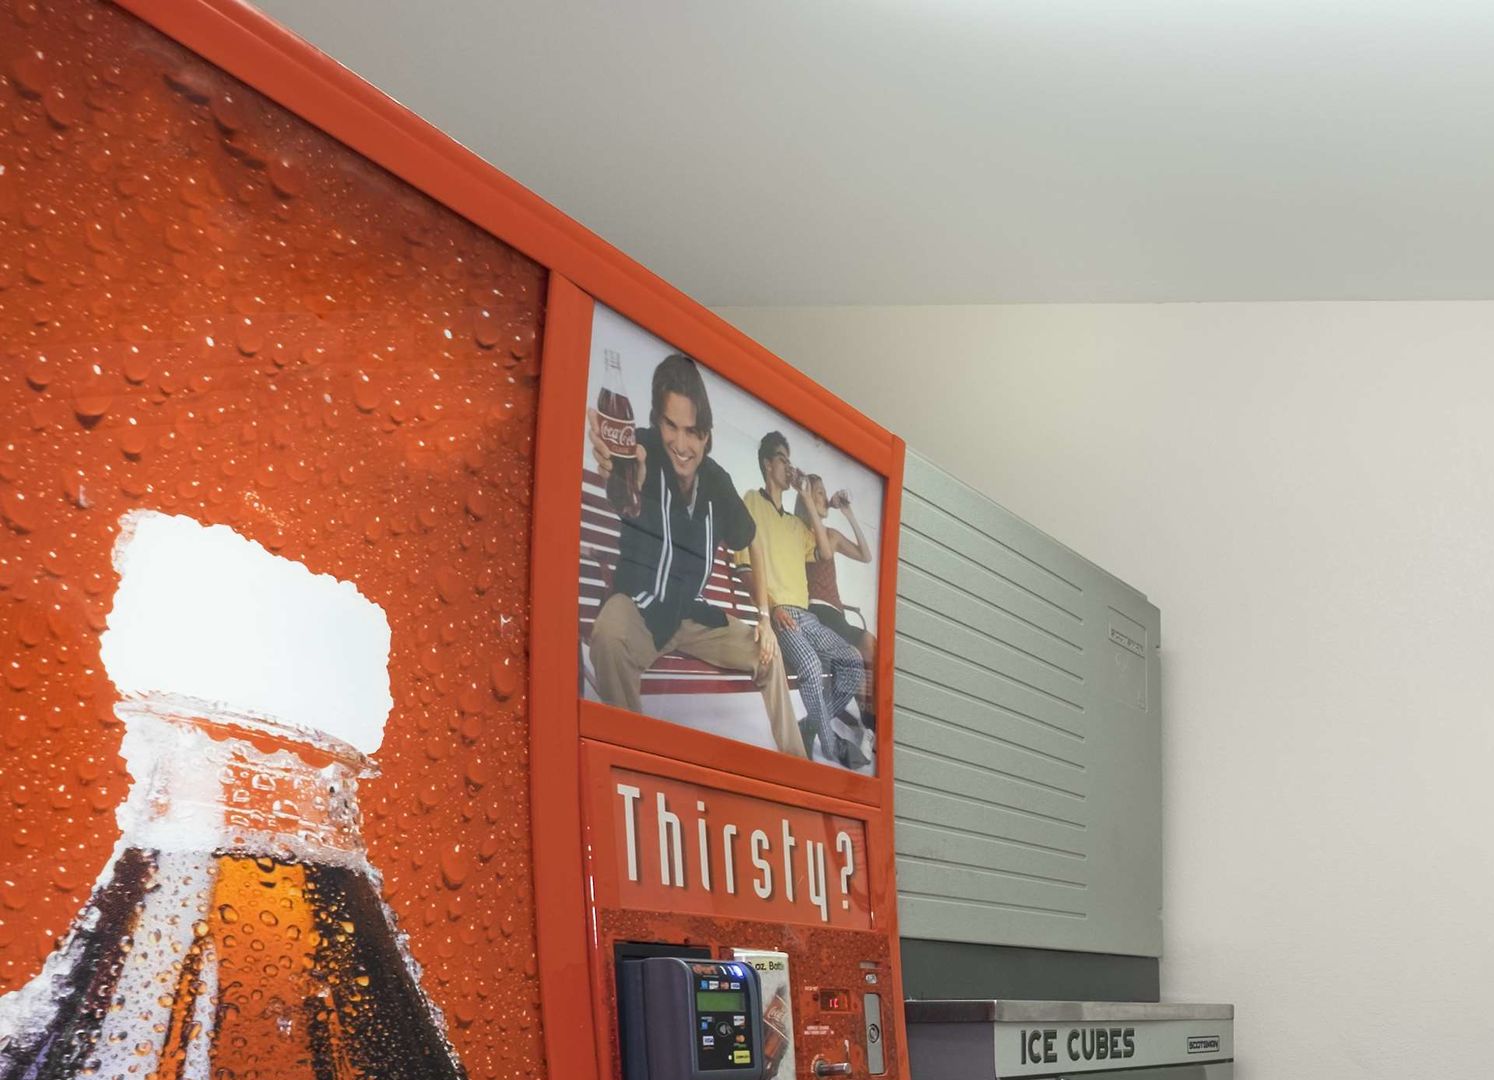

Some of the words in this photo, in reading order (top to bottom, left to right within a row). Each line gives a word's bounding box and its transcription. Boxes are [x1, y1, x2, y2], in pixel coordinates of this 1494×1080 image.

[617, 783, 854, 922] Thirsty?
[1020, 1030, 1057, 1064] ICE
[1067, 1028, 1135, 1061] CUBES
